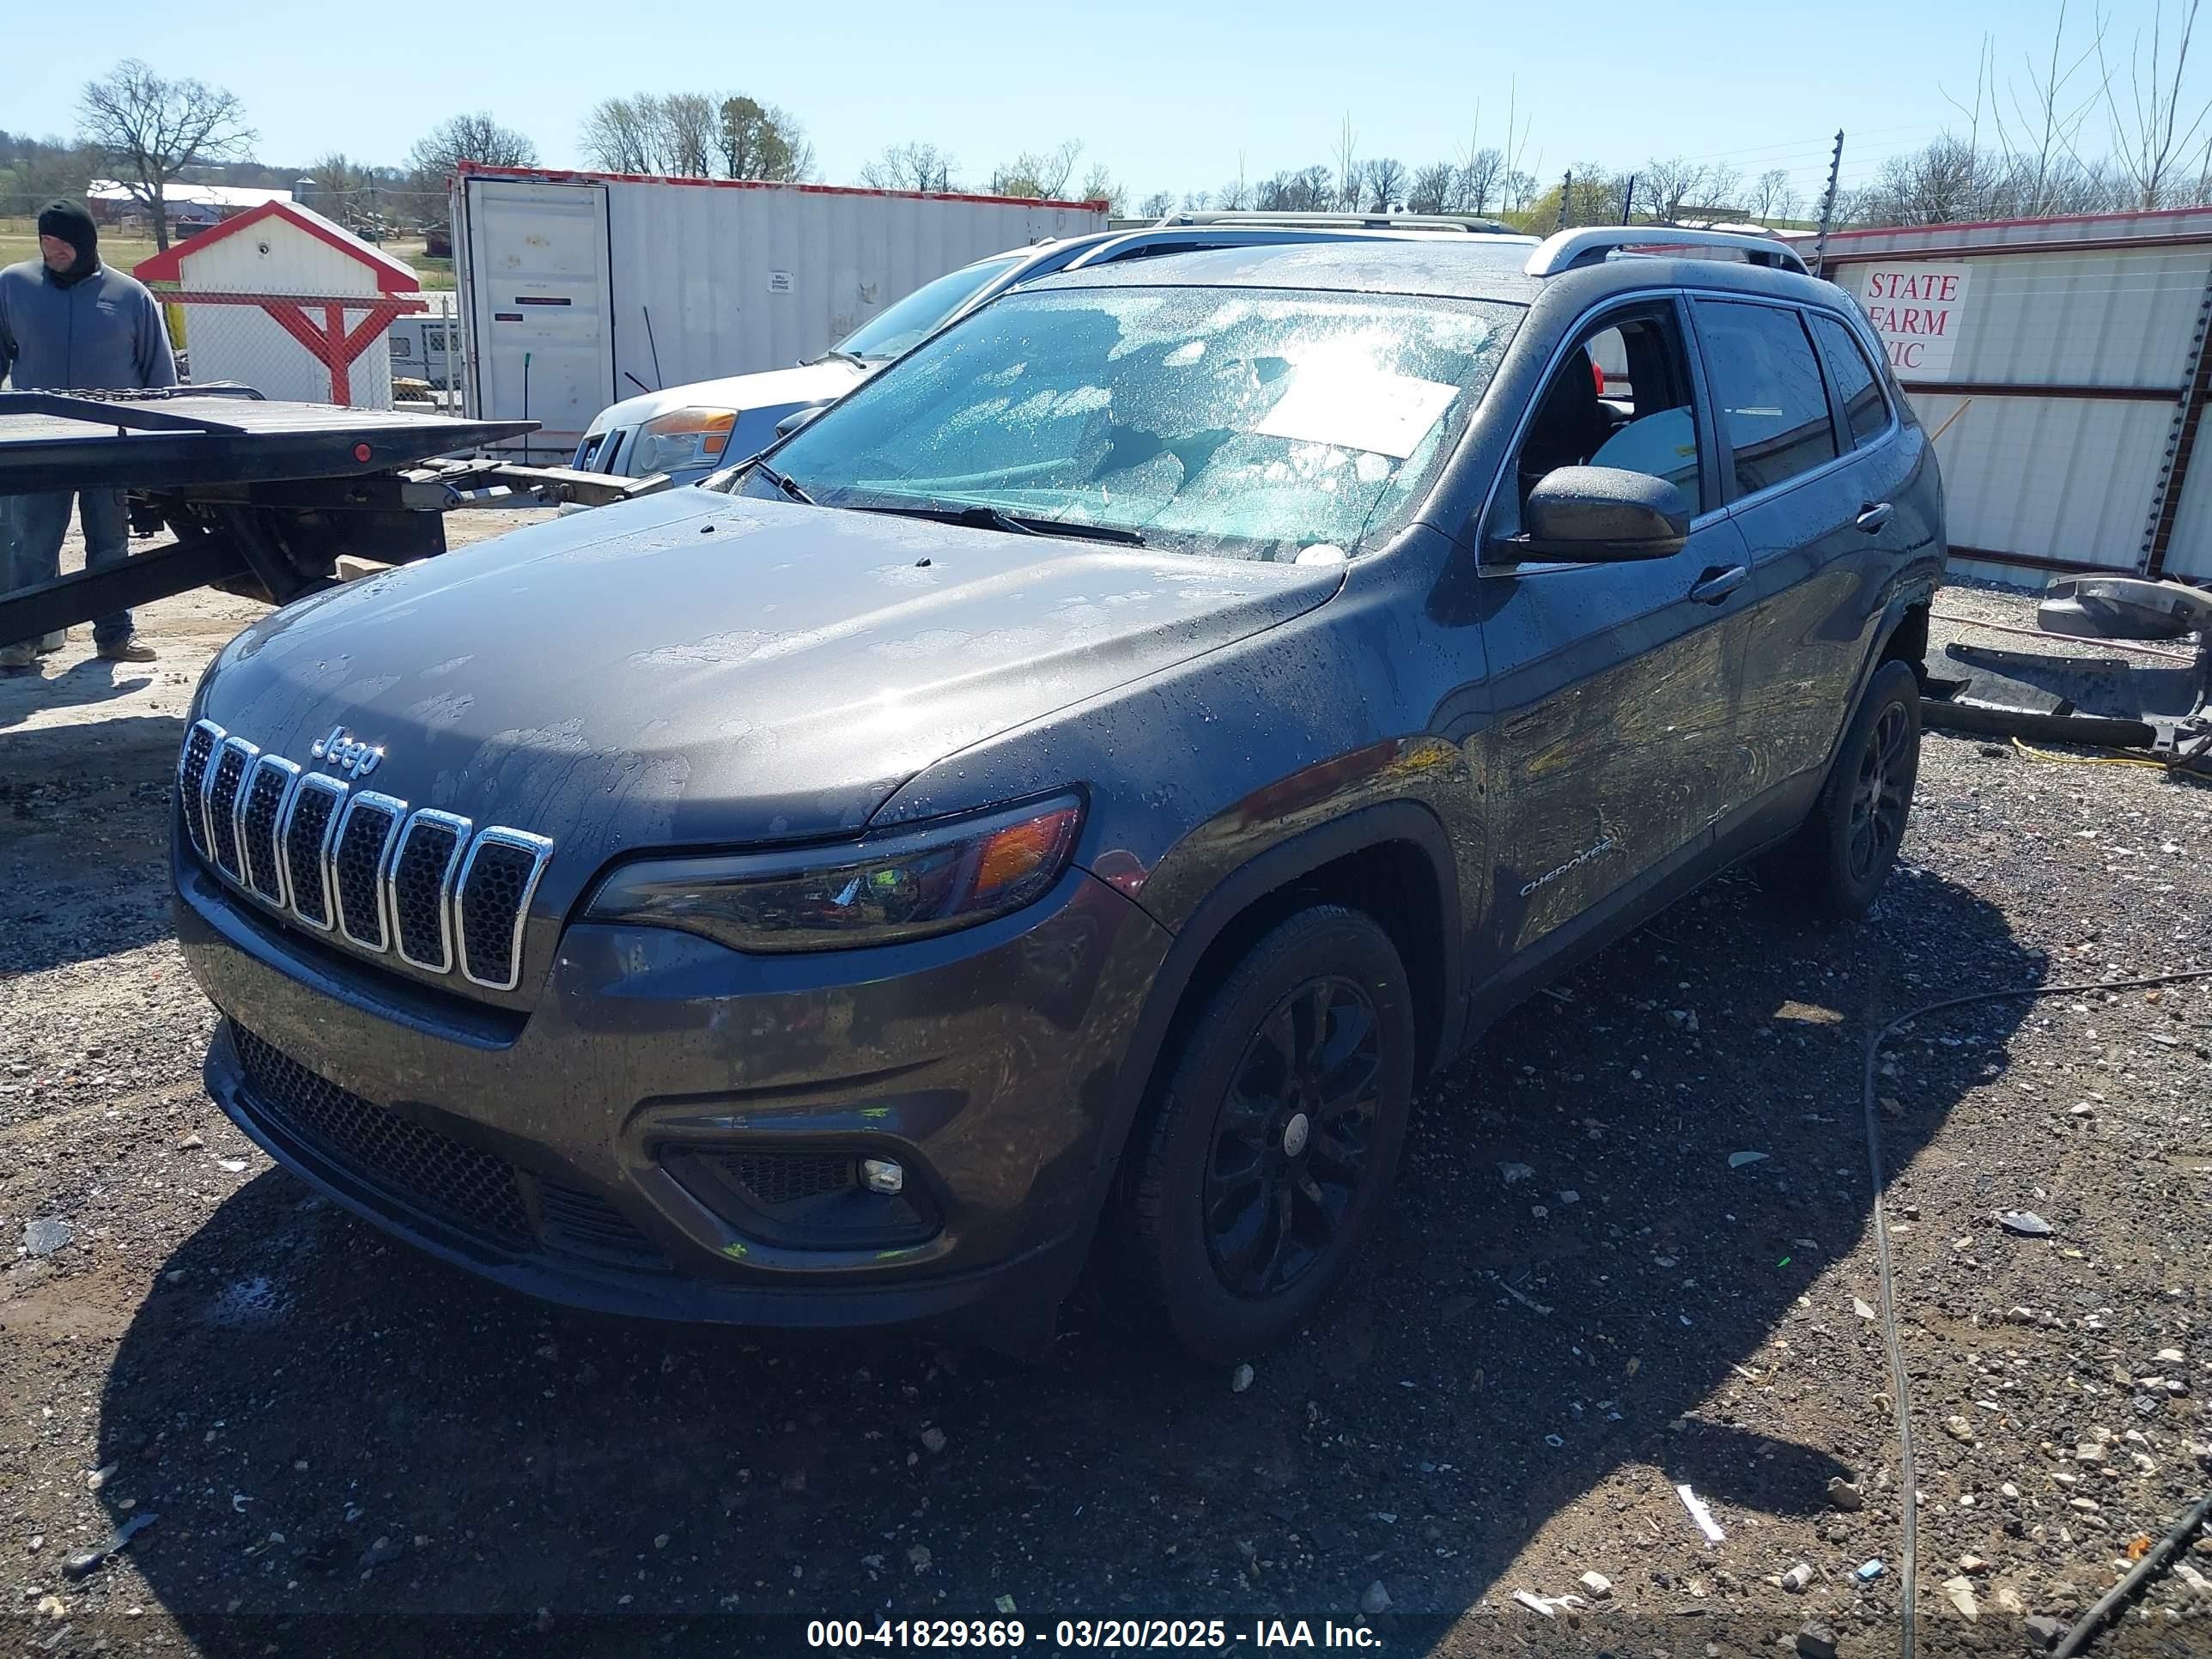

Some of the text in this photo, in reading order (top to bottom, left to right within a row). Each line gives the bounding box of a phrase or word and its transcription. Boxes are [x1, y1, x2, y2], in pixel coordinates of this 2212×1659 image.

[1868, 272, 1960, 301] STATE
[1869, 306, 1949, 336] FARM
[311, 726, 386, 781] Jeep
